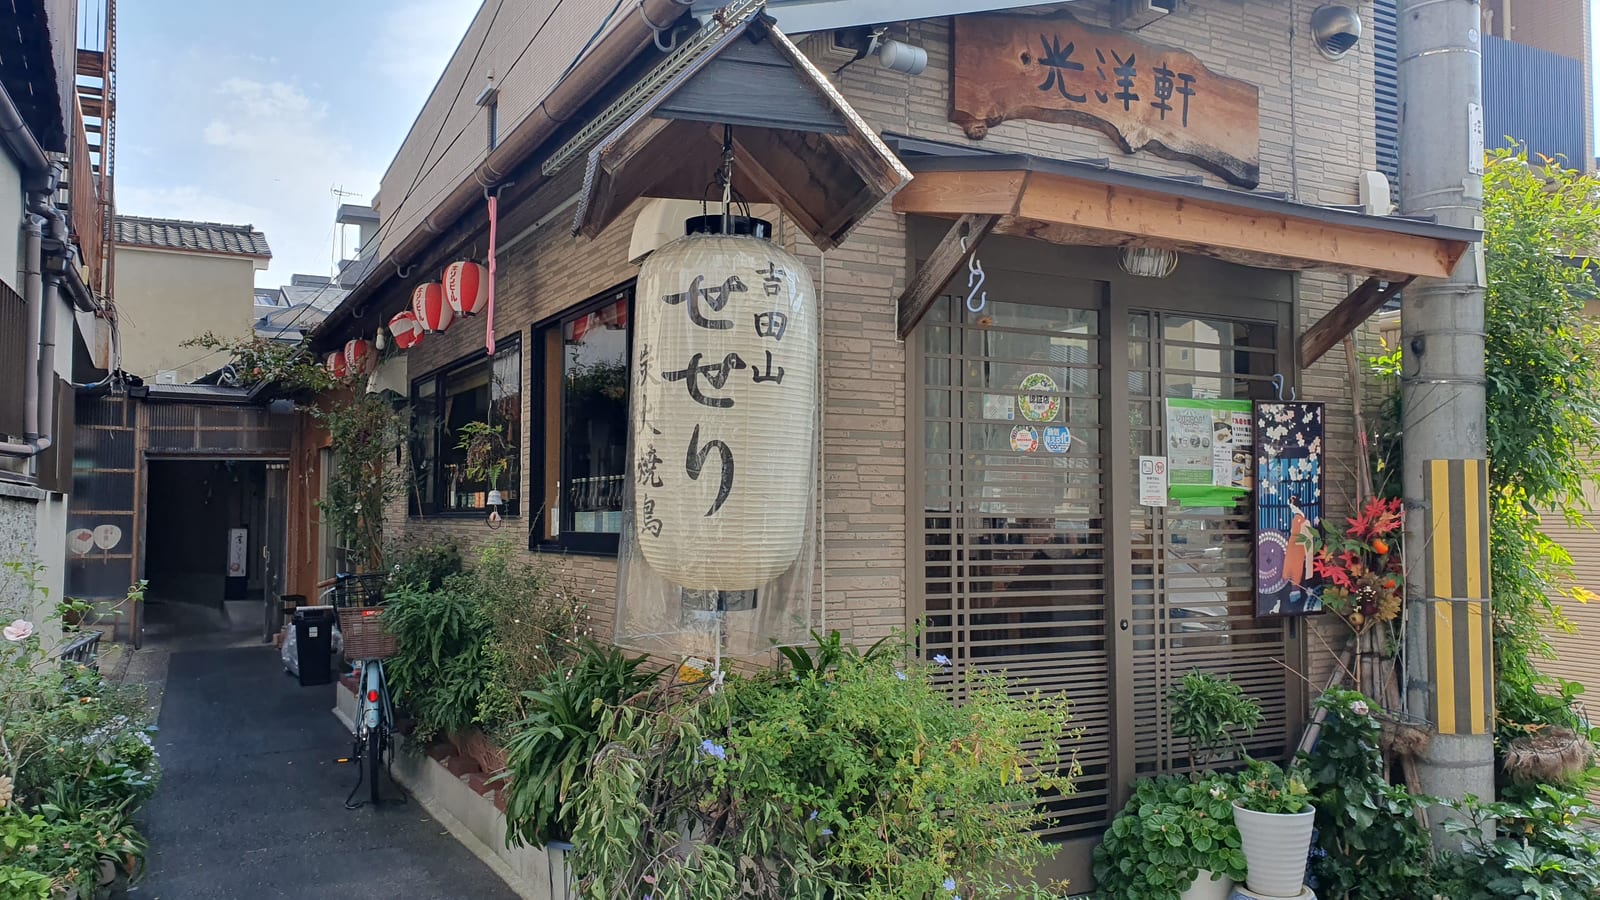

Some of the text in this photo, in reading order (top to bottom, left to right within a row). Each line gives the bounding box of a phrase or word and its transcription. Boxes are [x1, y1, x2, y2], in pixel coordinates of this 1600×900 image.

[1038, 33, 1197, 128] 光洋軒
[449, 265, 459, 302] キリンビール
[752, 261, 788, 385] 吉田山
